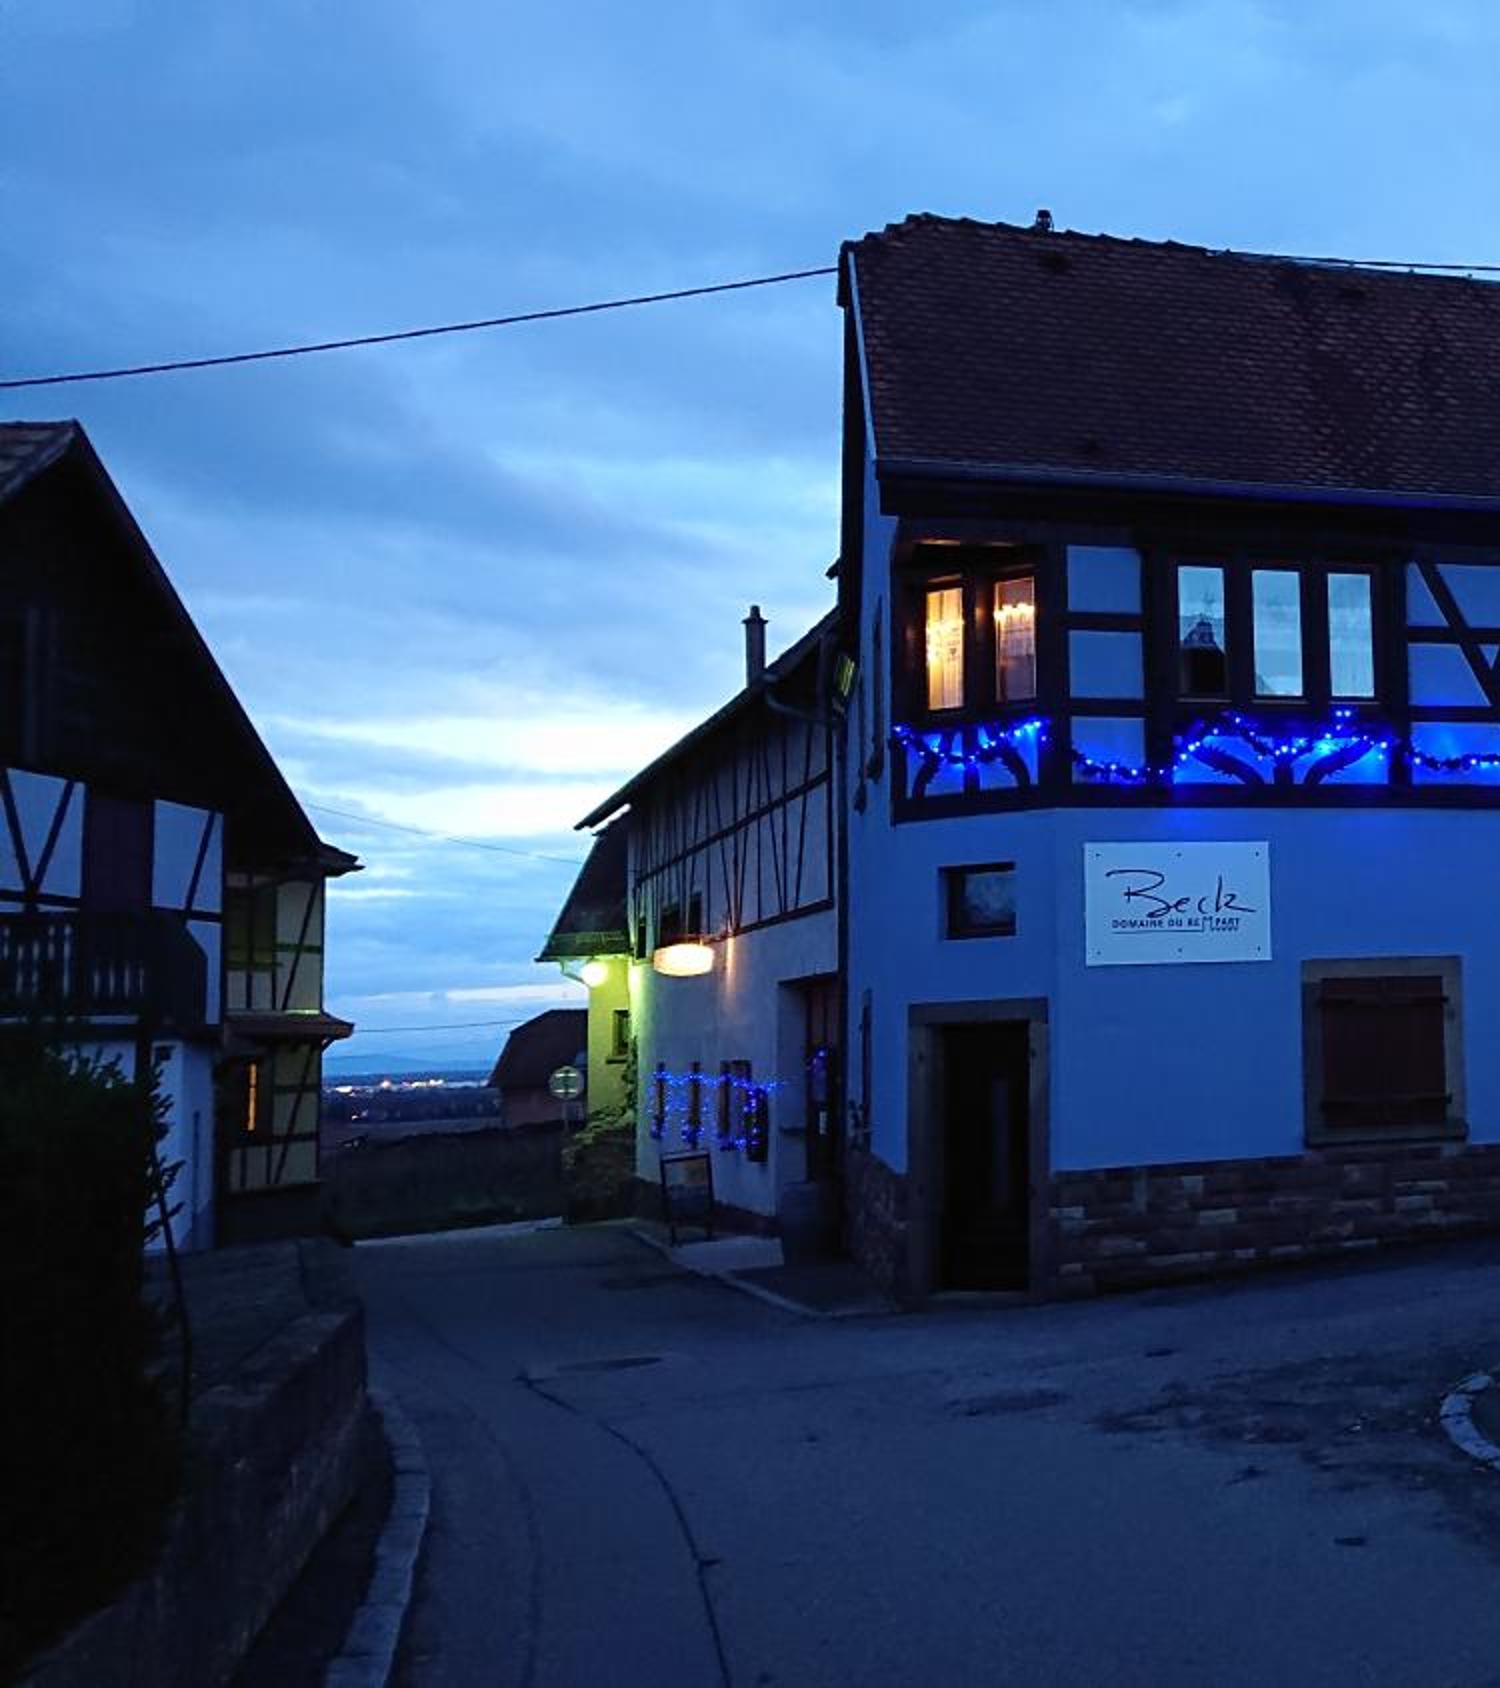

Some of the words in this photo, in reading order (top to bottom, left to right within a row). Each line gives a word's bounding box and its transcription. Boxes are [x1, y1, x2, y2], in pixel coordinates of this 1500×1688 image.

[1106, 869, 1257, 918] Beck
[1112, 918, 1164, 929] DOMAINE
[1167, 917, 1183, 927] DU
